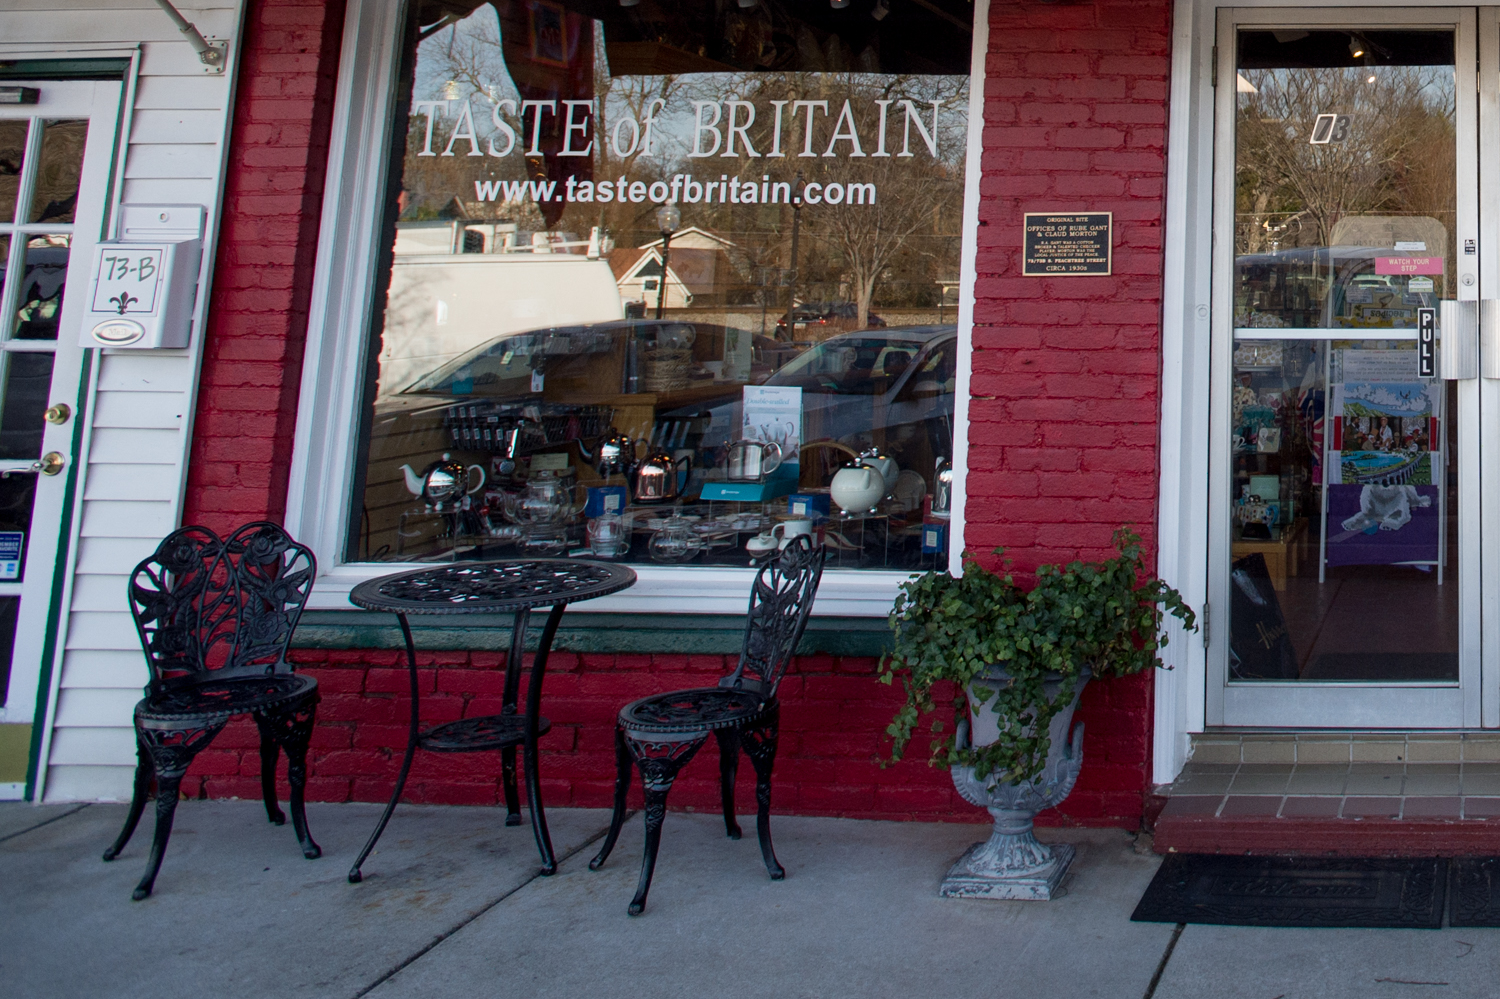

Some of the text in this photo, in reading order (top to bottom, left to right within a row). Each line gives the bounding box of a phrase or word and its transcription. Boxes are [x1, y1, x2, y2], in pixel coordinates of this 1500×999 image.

[414, 97, 946, 158] TASTE of BRITAIN
[1314, 116, 1351, 142] 73
[474, 174, 877, 205] www.tasteofbritain.com
[105, 256, 156, 282] 73-B
[1422, 313, 1432, 373] PULL
